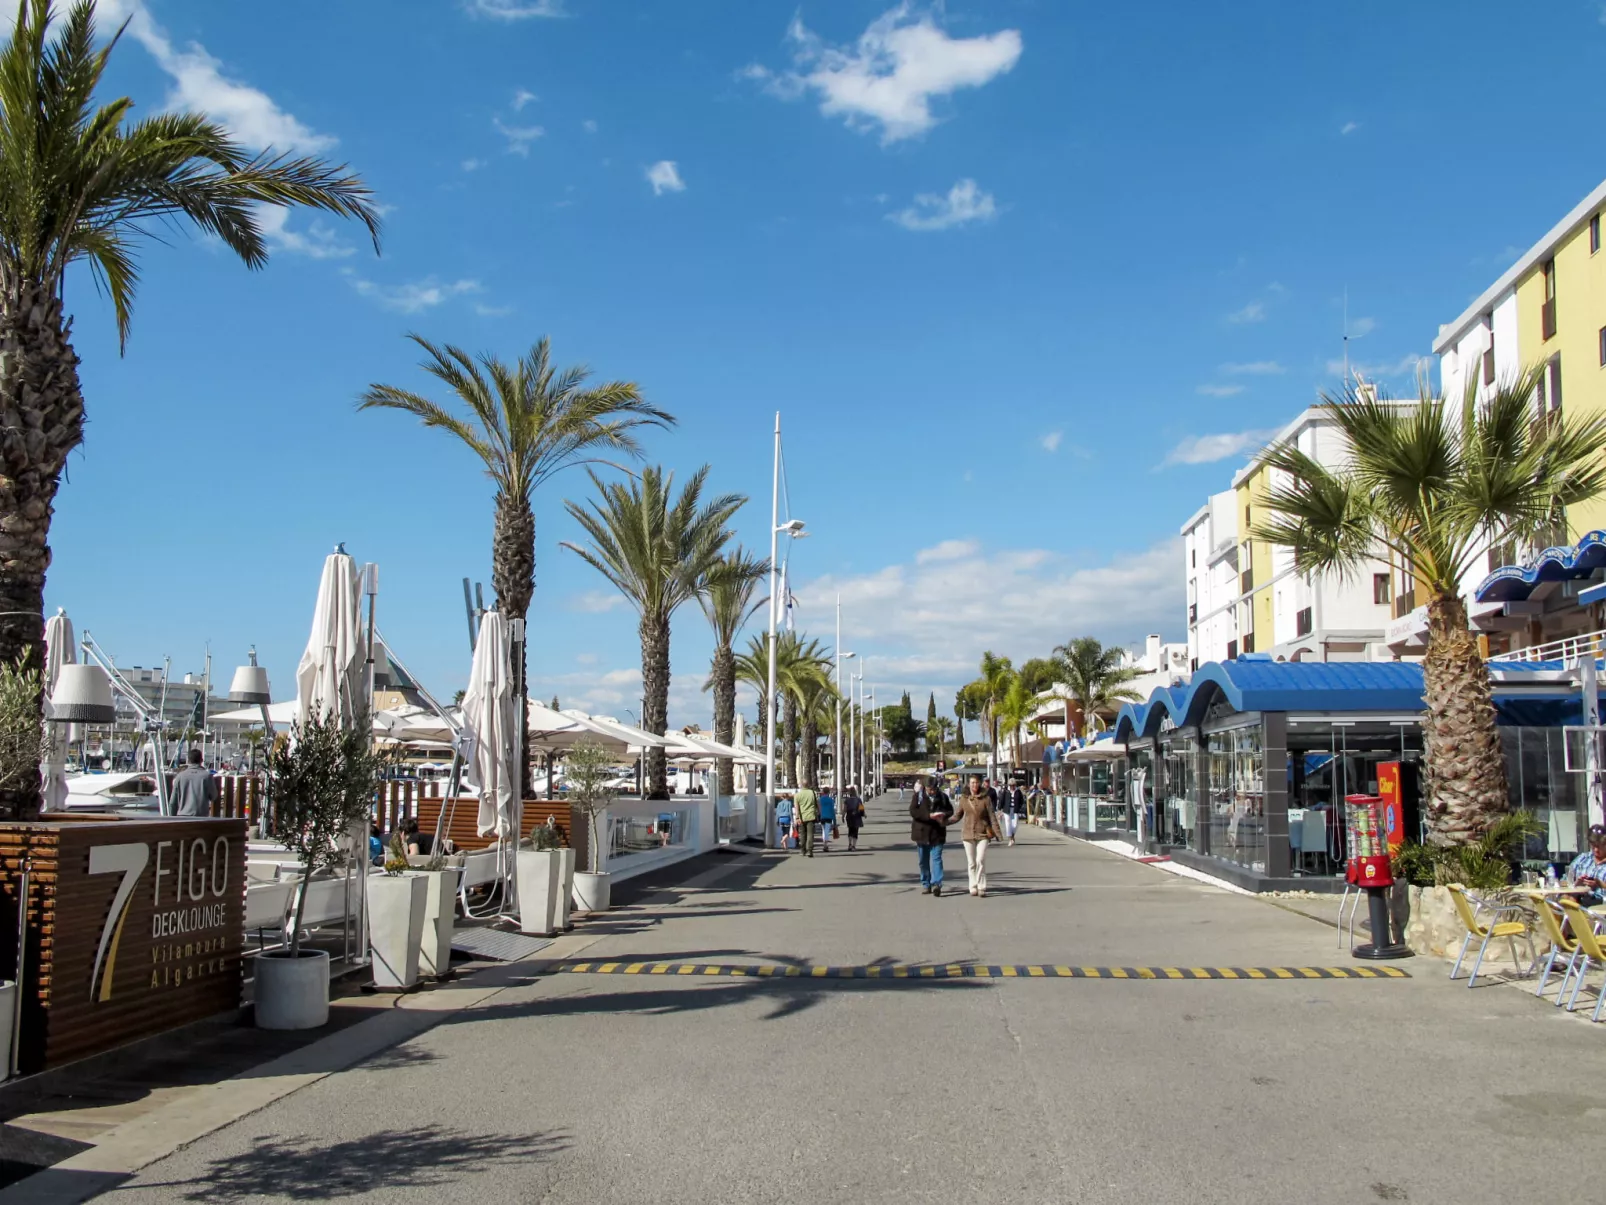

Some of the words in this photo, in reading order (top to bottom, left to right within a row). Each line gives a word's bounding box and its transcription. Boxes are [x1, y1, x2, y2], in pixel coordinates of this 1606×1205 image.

[88, 842, 149, 1001] 7
[154, 835, 229, 906] FIGO
[152, 903, 226, 939] DECKLOUNGE
[152, 937, 225, 964] Vilamoura
[150, 958, 225, 989] Algarve
